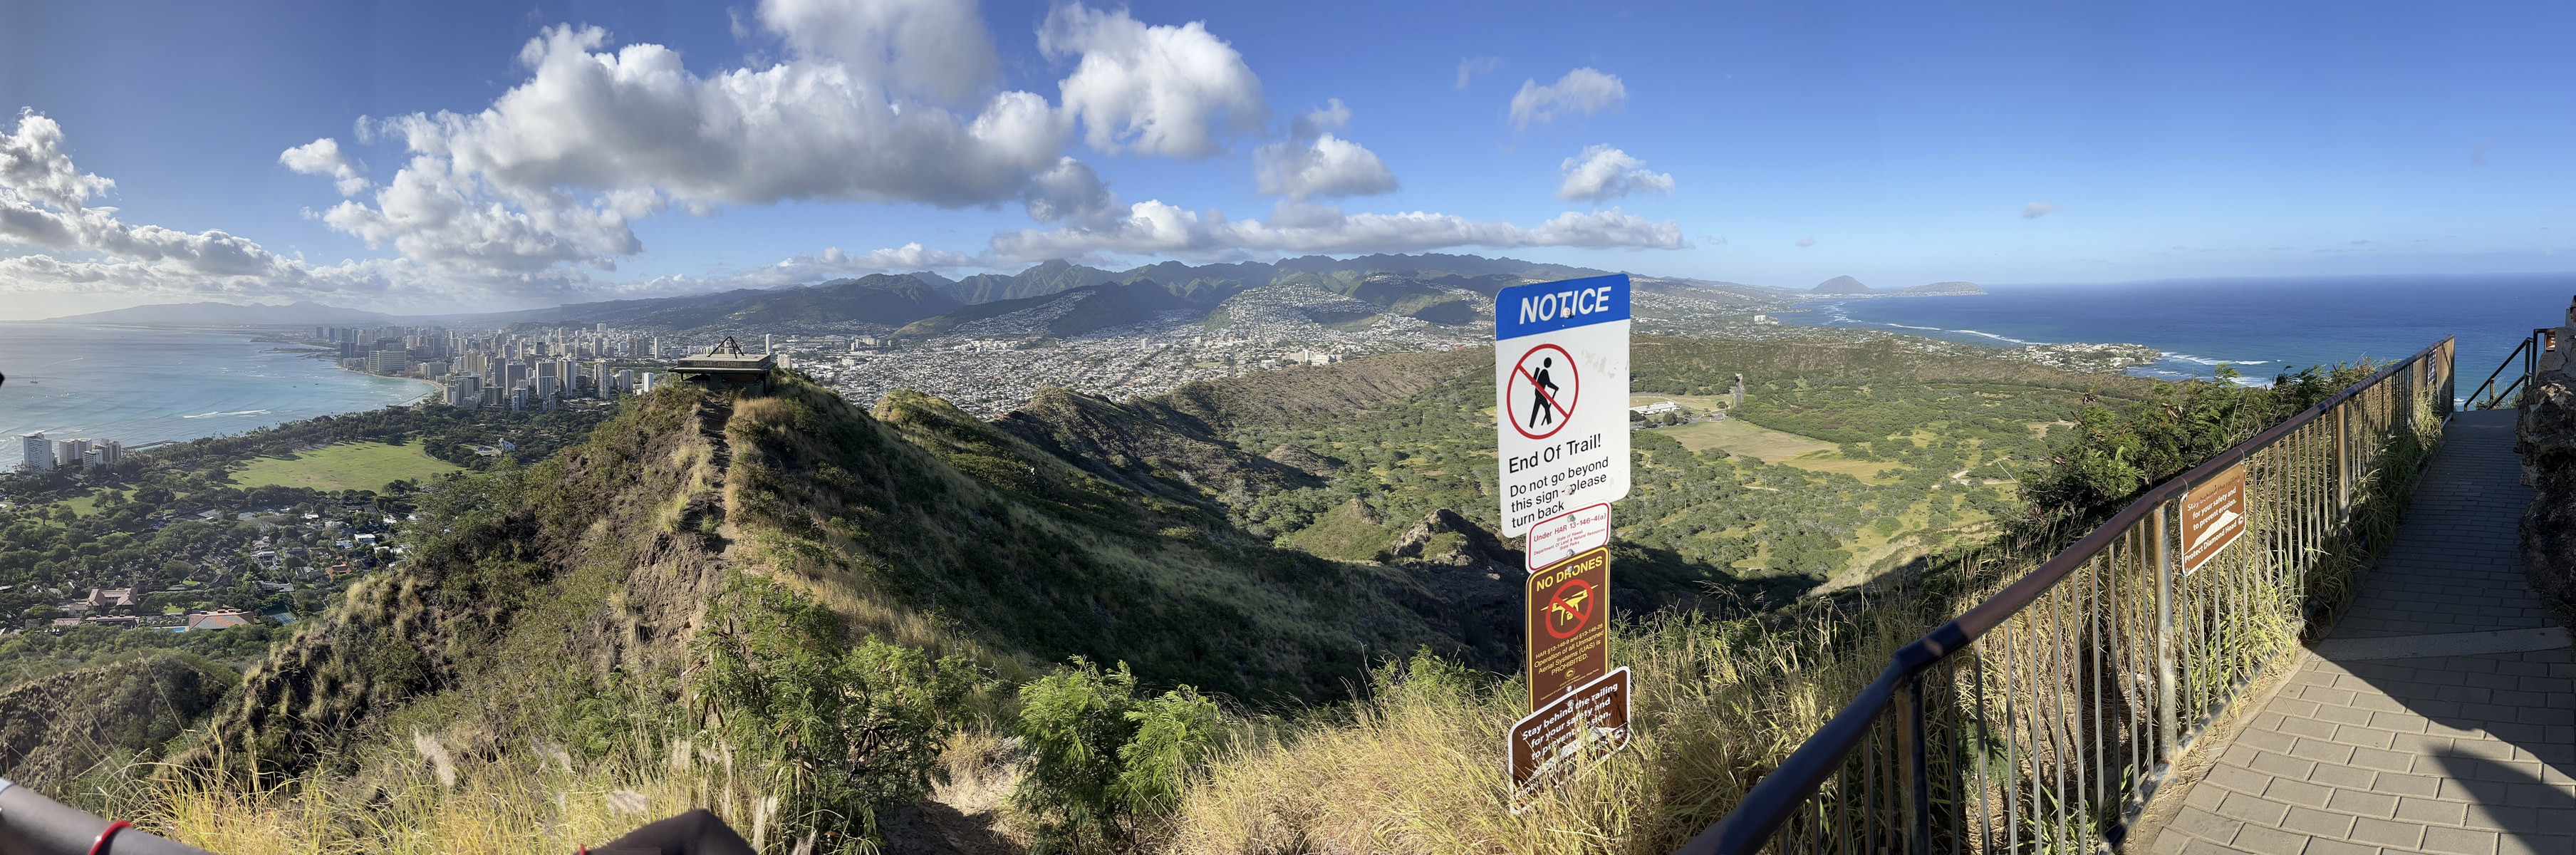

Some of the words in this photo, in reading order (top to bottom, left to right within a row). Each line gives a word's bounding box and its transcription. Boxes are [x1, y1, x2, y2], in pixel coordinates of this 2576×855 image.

[1519, 286, 1611, 325] NOTICE
[1509, 451, 1538, 474] End
[1544, 445, 1561, 462] Of
[1567, 433, 1601, 455] Trail!
[1510, 484, 1526, 497] Do
[1530, 476, 1548, 492] not
[1551, 472, 1565, 486] go
[1568, 456, 1609, 478] beyond
[1511, 497, 1532, 512] this
[1536, 489, 1558, 503] sign
[1569, 474, 1606, 495] please
[2188, 502, 2199, 511] Stay
[2200, 487, 2217, 503] behind
[2226, 475, 2240, 487] railing
[1512, 514, 1534, 528] turn
[1537, 501, 1564, 519] back
[2200, 509, 2218, 528] prevent
[2218, 499, 2237, 514] erosion.
[2201, 503, 2213, 516] your
[2213, 494, 2227, 507] safety
[2228, 486, 2236, 497] and
[1533, 531, 1552, 542] Under
[1554, 524, 1567, 534] HAR
[1569, 512, 1606, 529] 13-146-4(a)
[2184, 545, 2203, 564] Protect
[2203, 530, 2225, 549] Diamond
[2225, 520, 2237, 534] Head
[1533, 545, 1554, 555] Department
[1537, 576, 1553, 591] NO
[1557, 556, 1602, 584] DRONES
[1534, 651, 1561, 668] Operation
[1576, 629, 1604, 647] Unmanned
[1535, 650, 1547, 659] HAR
[1538, 661, 1554, 674] Aerial
[1555, 651, 1578, 665] Systems
[1579, 641, 1595, 655] (UAS)
[1551, 653, 1589, 675] PROHIBITED.
[1522, 724, 1542, 740] Stay
[1544, 705, 1573, 727] behind
[1575, 698, 1589, 709] the
[1591, 683, 1618, 701] railing
[1531, 735, 1544, 748] for
[1545, 722, 1565, 740] your
[1567, 708, 1593, 727] safety
[1594, 696, 1611, 711] and
[1531, 750, 1541, 760] to
[1542, 729, 1575, 755] prevent
[1577, 711, 1611, 732] eosion.
